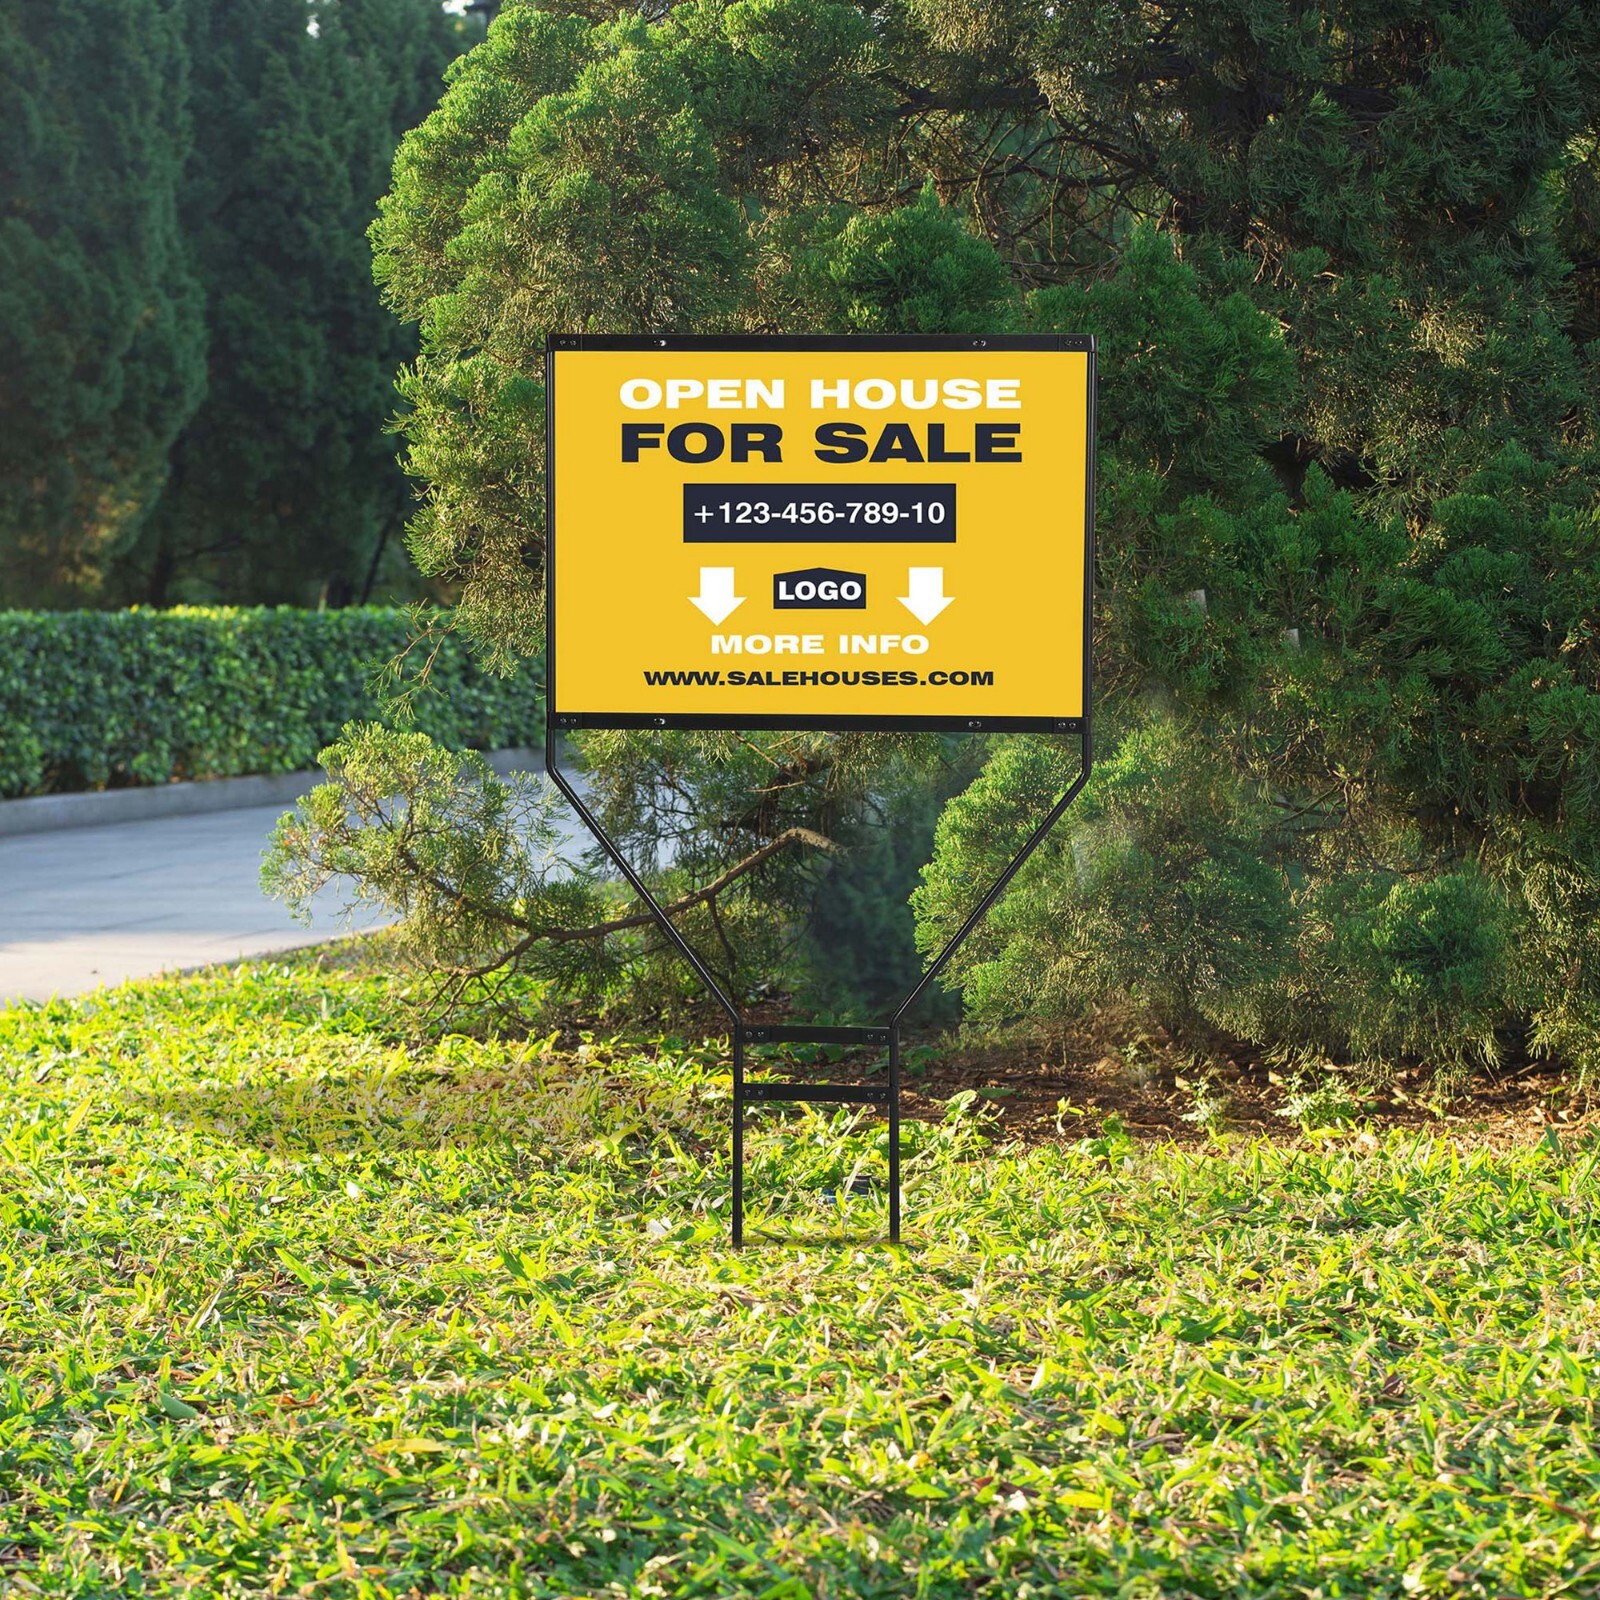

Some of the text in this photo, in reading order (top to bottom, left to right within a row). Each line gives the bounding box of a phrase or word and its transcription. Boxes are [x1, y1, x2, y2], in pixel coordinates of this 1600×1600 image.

[619, 378, 1022, 410] OPEN HOUSE
[621, 422, 1023, 464] FOR SALE
[693, 501, 946, 525] +123-456-789-10
[778, 580, 863, 602] LOGO
[711, 634, 930, 655] MORE INFO
[643, 670, 994, 686] WWW.SALEHOUSES.COM
